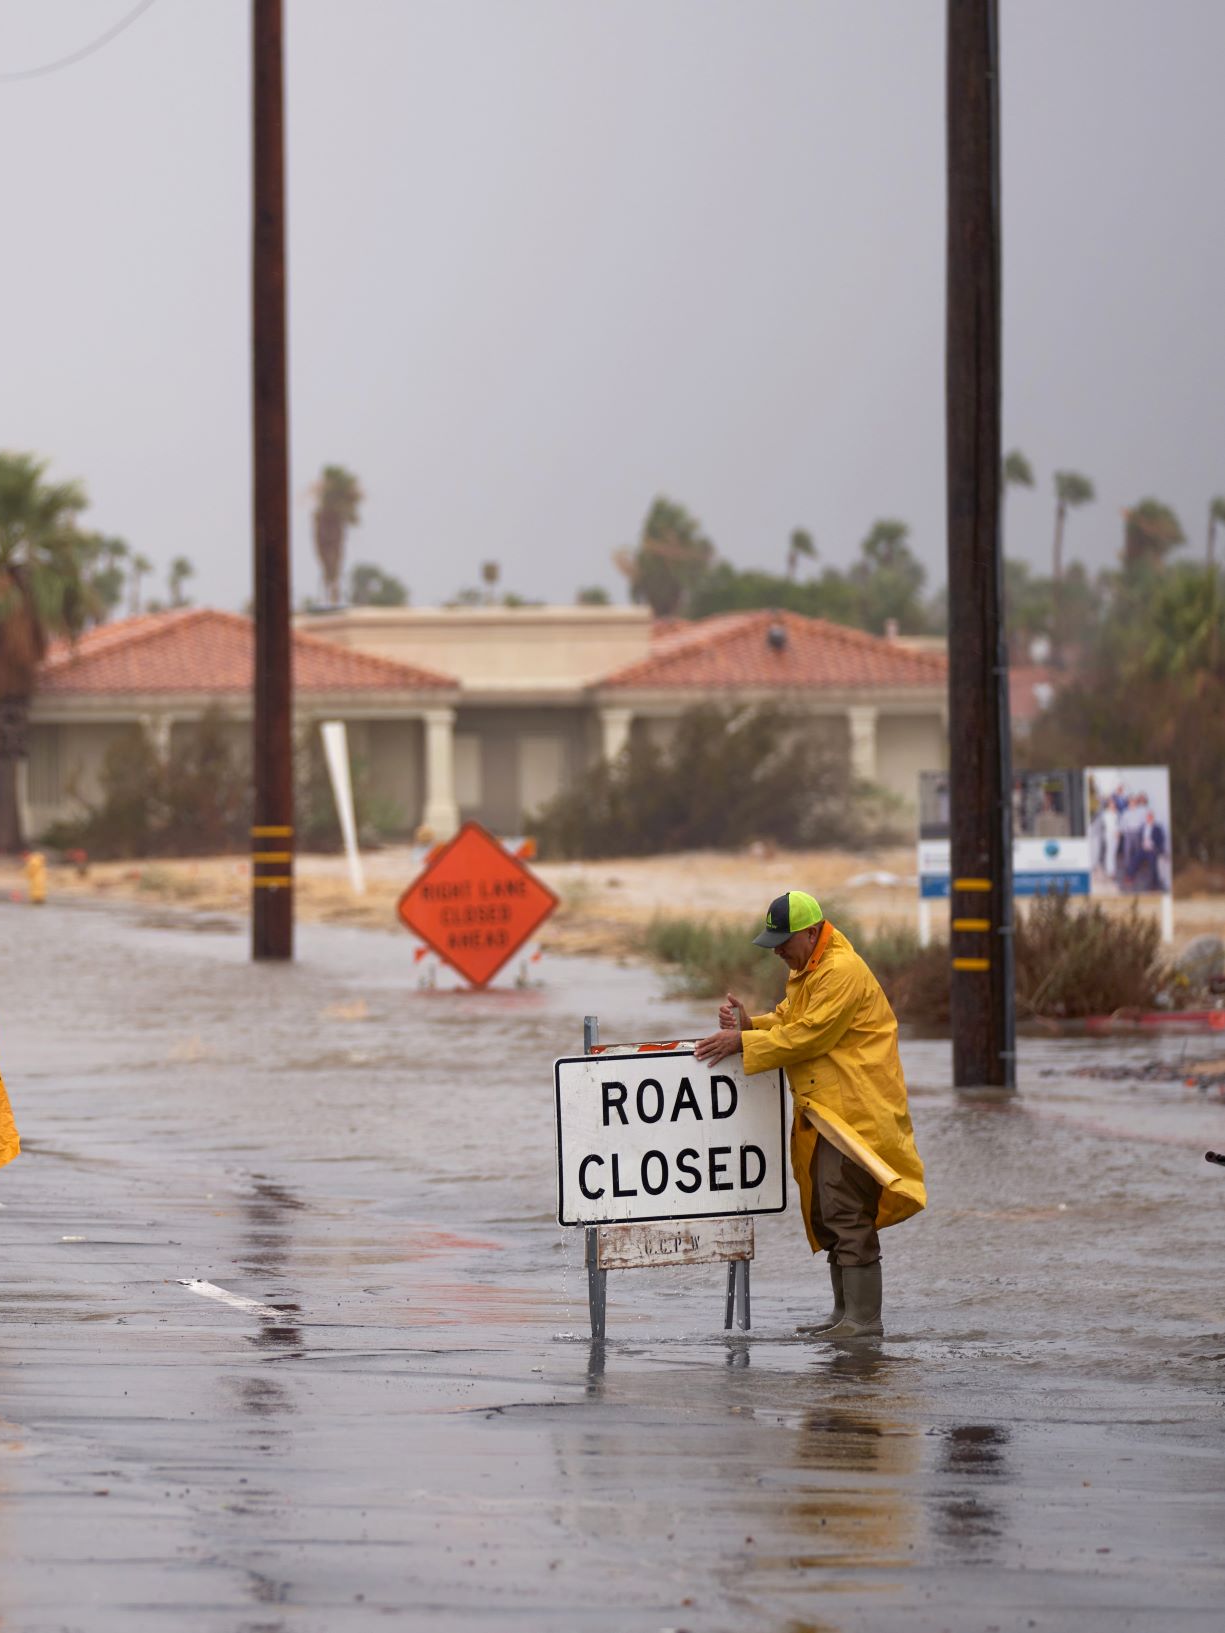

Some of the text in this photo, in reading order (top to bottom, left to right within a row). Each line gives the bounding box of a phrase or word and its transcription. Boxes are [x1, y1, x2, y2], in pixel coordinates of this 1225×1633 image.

[422, 879, 527, 900] RIGHT LANE
[440, 904, 510, 927] CLOSED
[448, 928, 508, 950] AHEAD
[601, 1075, 738, 1127] ROAD
[578, 1144, 767, 1200] CLOSED
